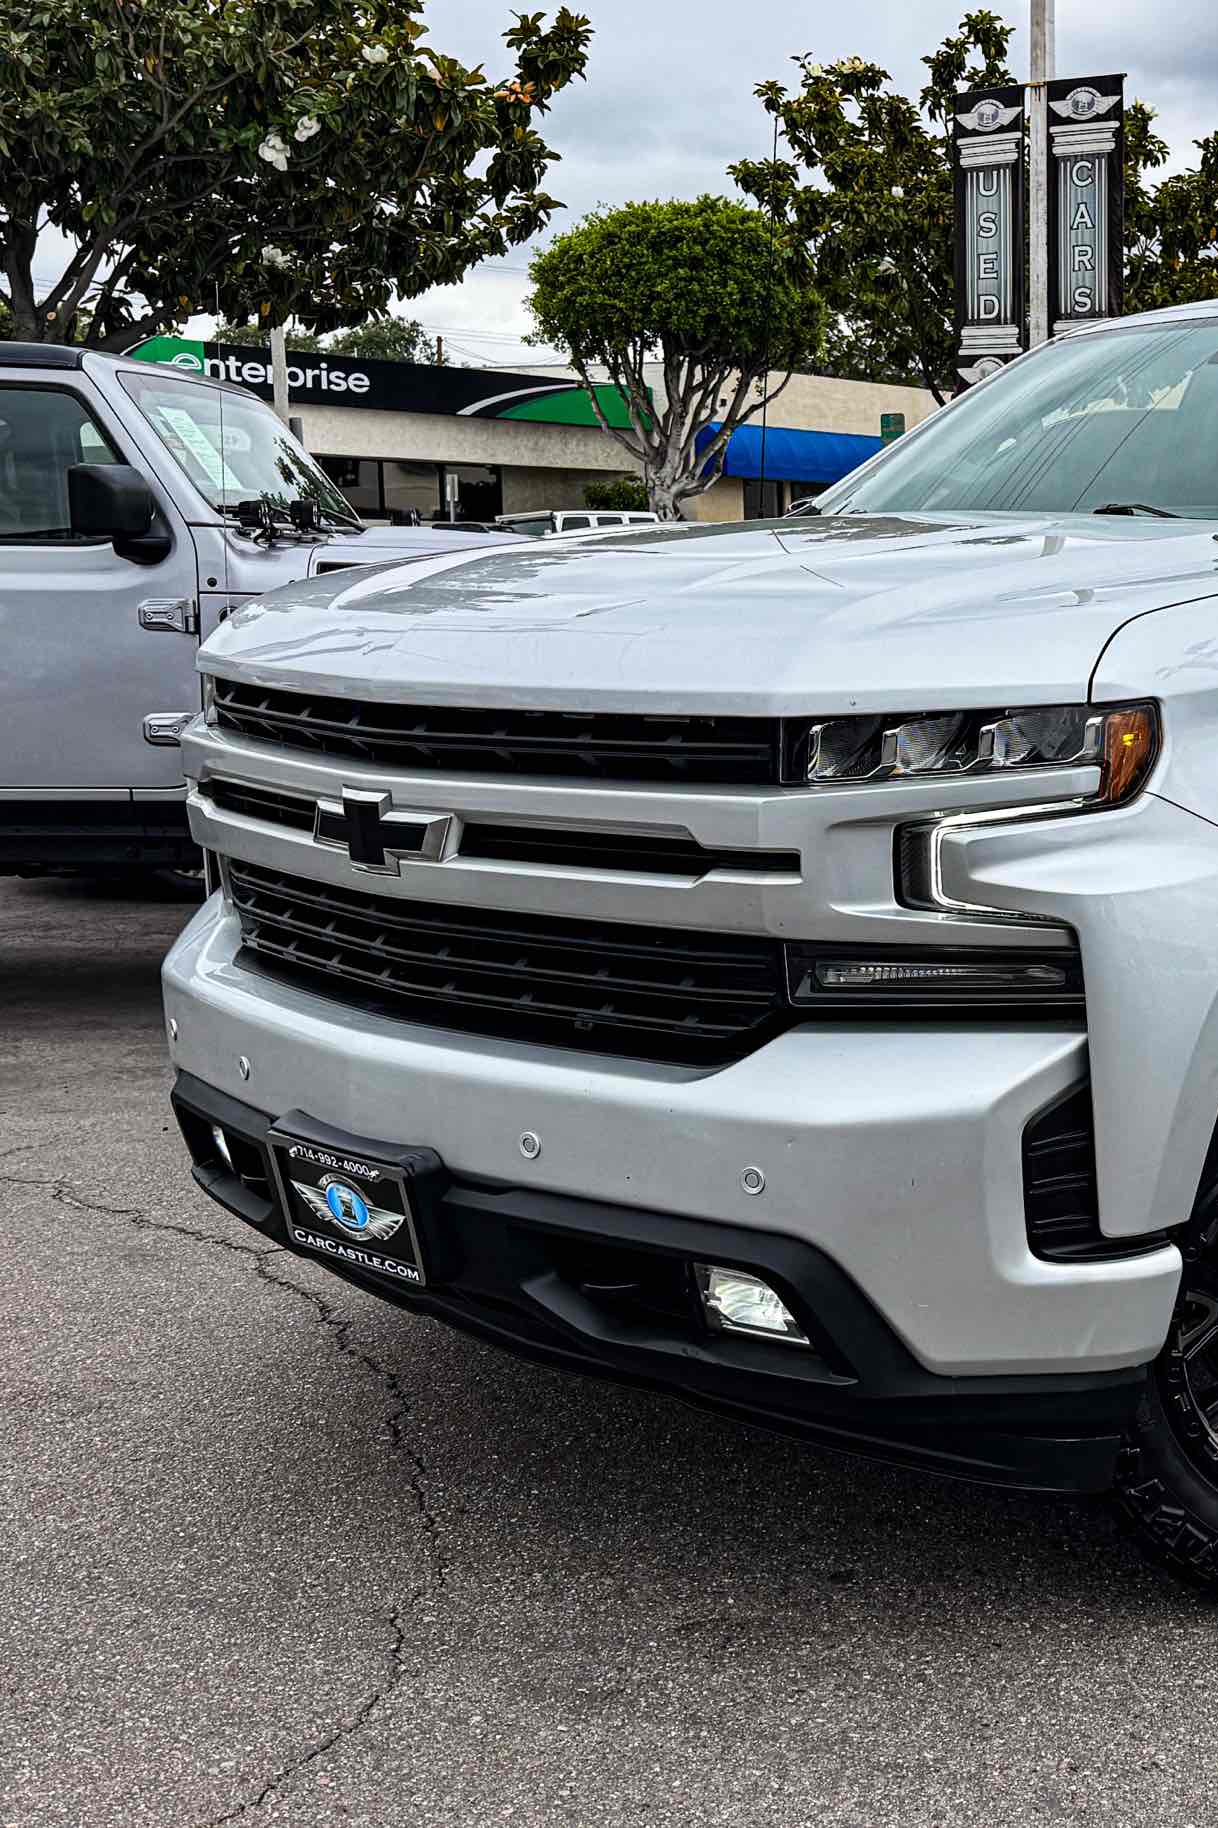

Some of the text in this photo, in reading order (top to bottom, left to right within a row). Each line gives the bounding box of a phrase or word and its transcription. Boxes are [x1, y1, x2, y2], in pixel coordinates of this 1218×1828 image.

[977, 171, 1000, 320] USED
[1070, 161, 1095, 314] CARS
[172, 352, 371, 393] enterprise
[295, 1145, 370, 1176] 714-992-4000
